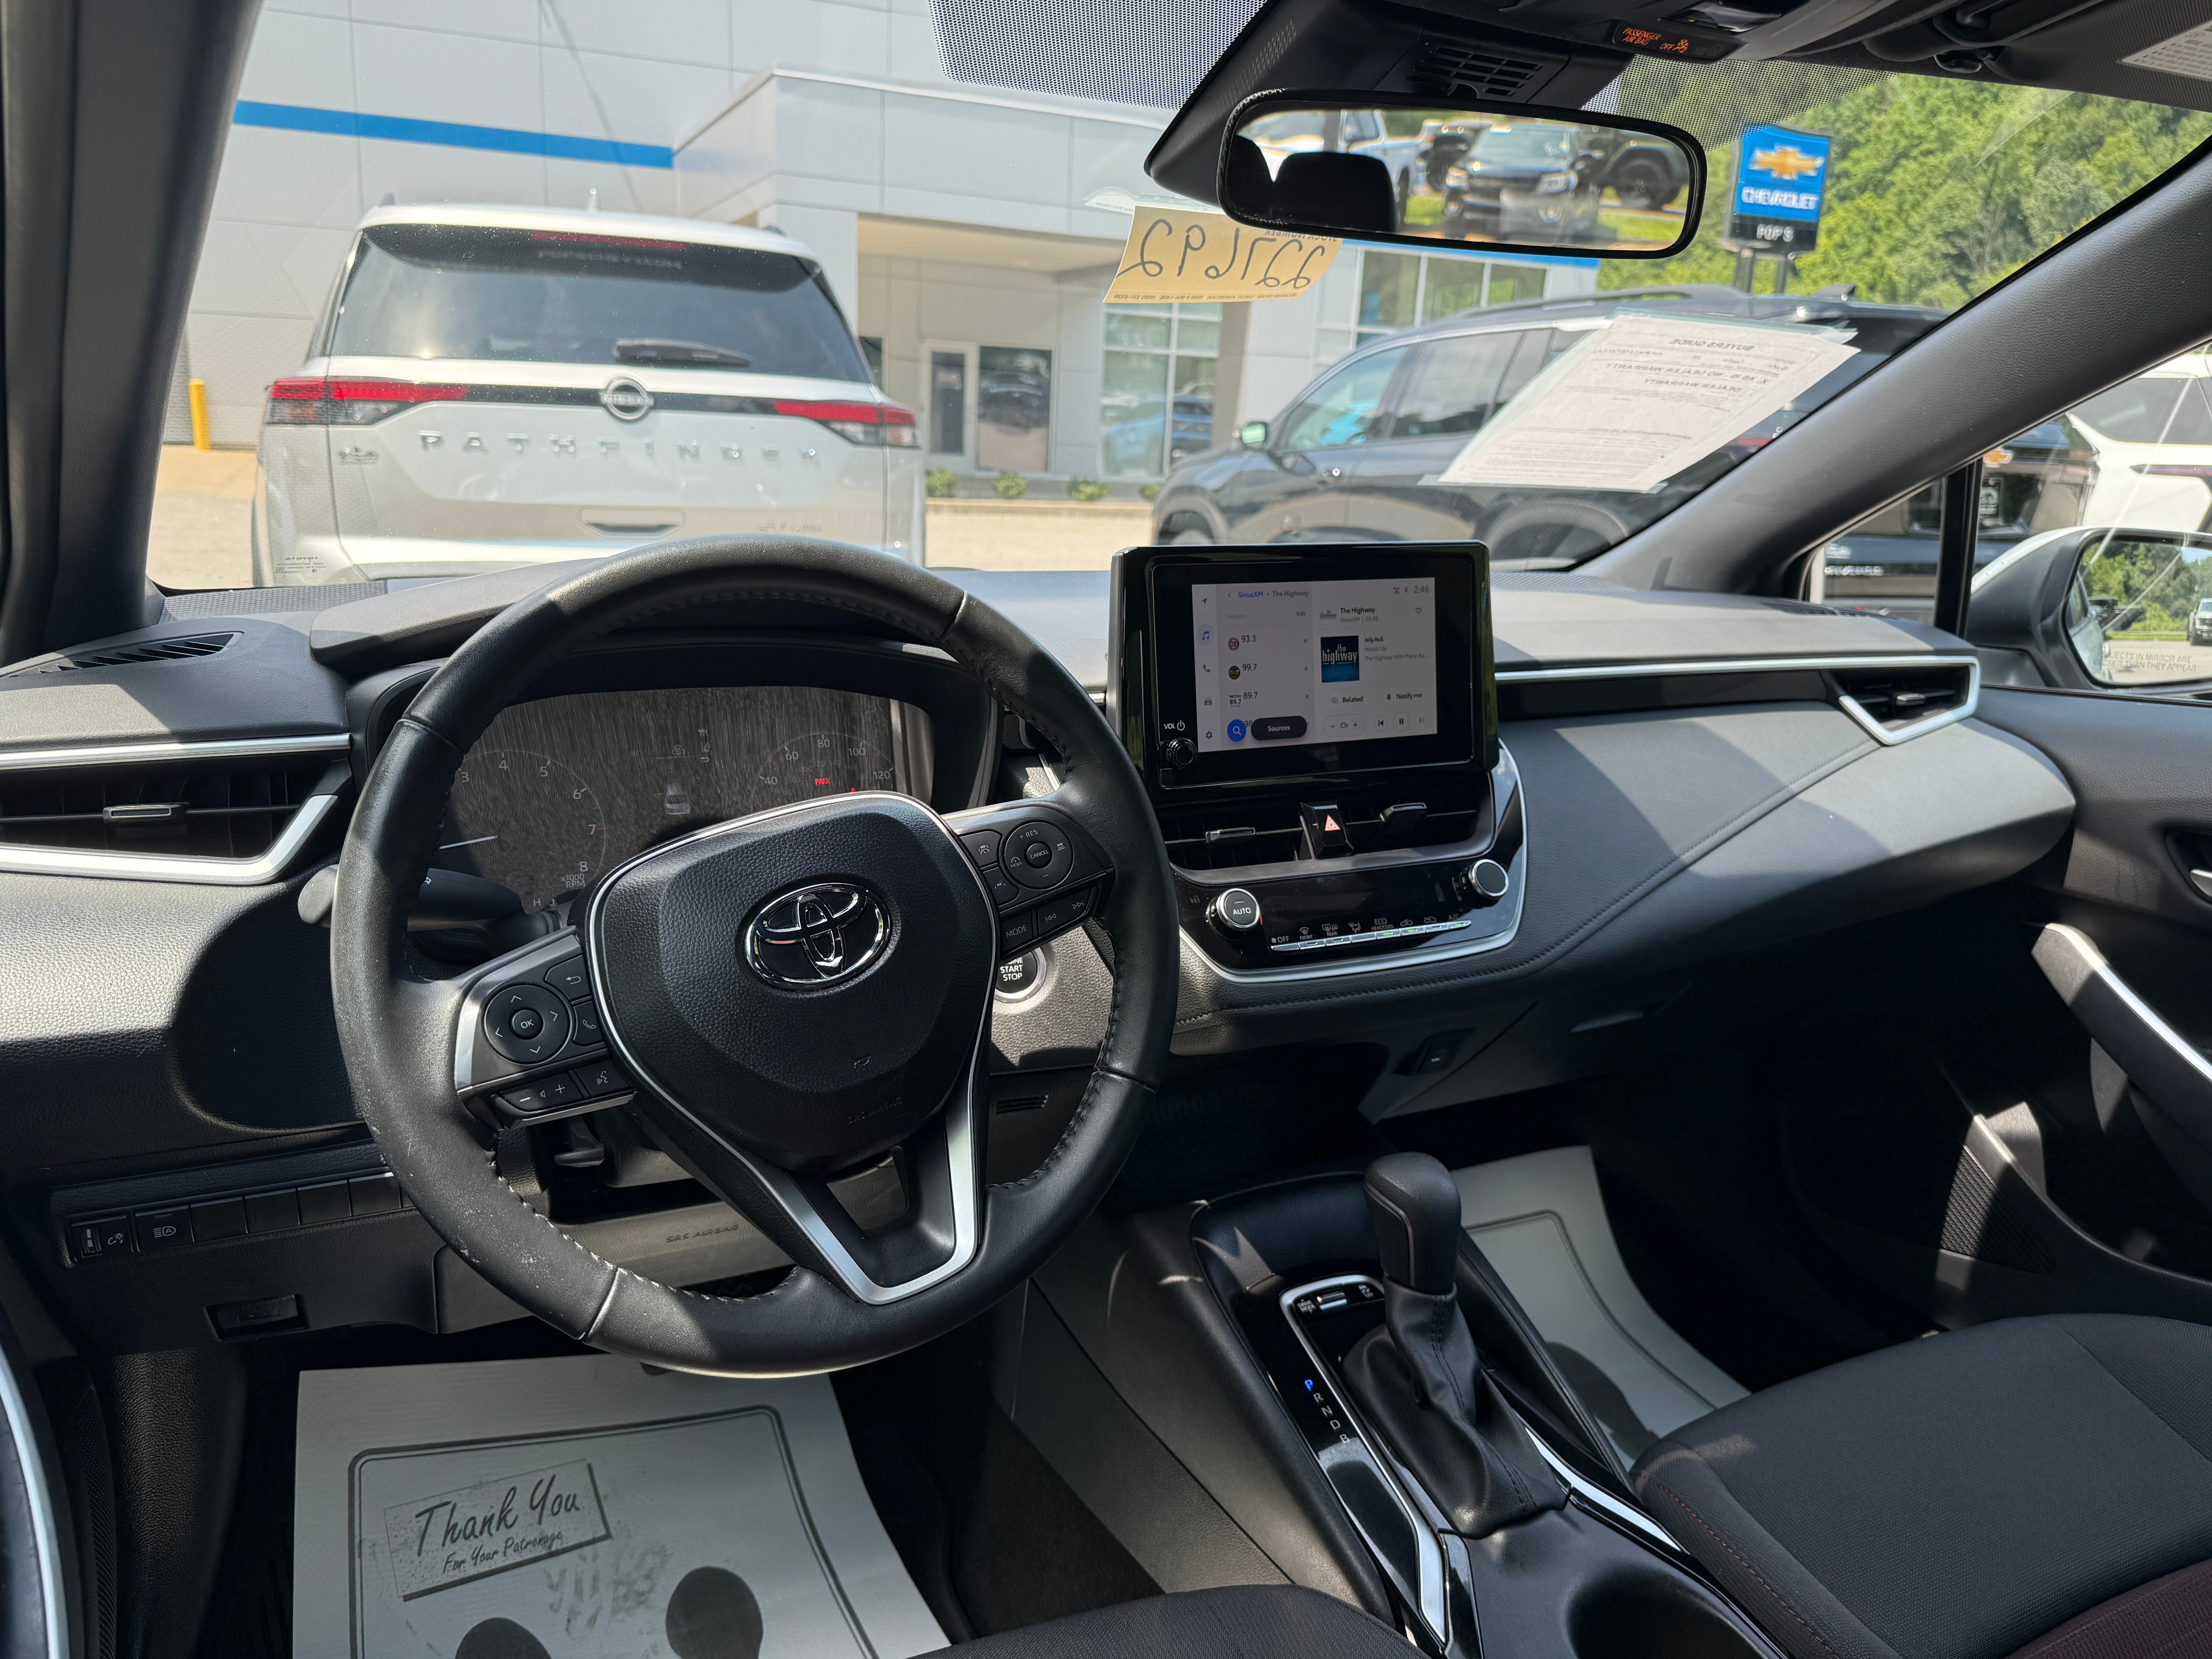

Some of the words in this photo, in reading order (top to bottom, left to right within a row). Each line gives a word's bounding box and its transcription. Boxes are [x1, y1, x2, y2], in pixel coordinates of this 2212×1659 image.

[1623, 27, 1661, 41] PASSENGER
[1741, 186, 1819, 210] CHEVROLET
[417, 430, 819, 463] PATHFINDER
[1284, 590, 1309, 598] Highway
[1414, 585, 1429, 594] 2:46
[1351, 606, 1376, 615] Highway
[1241, 635, 1257, 643] 93.3
[1337, 643, 1346, 653] the
[1322, 649, 1358, 665] highway
[2104, 651, 2134, 659] JECTS
[2136, 653, 2143, 661] IN
[2145, 653, 2176, 662] MIRROR
[2176, 655, 2193, 664] ARE
[2146, 662, 2167, 670] THEY
[2167, 663, 2197, 673] APPEAR
[817, 739, 831, 748] 80
[785, 752, 799, 761] 60
[848, 747, 866, 756] 100
[499, 760, 508, 771] 4
[541, 766, 548, 777] 5
[872, 770, 890, 780] 120
[462, 772, 470, 783] 3
[764, 776, 778, 785] 40
[573, 789, 582, 799] 6
[588, 824, 596, 835] 7
[1025, 829, 1038, 838] RES
[1030, 849, 1049, 859] CANCEL
[580, 861, 589, 872] 8
[562, 874, 585, 882] x1000
[566, 880, 586, 889] RPM
[533, 898, 541, 907] H
[1233, 907, 1251, 915] AUTO
[1006, 924, 1027, 938] MODE
[1000, 965, 1023, 974] START
[1003, 972, 1023, 981] STOP
[521, 1019, 534, 1029] OK
[666, 1233, 690, 1243] SRS
[692, 1224, 739, 1238] AIRBAG
[1305, 1379, 1313, 1391] P
[1313, 1393, 1324, 1404] R
[1321, 1405, 1333, 1417] N
[1329, 1419, 1341, 1431] D
[1339, 1434, 1350, 1443] B
[415, 1485, 519, 1557] Thank
[529, 1474, 580, 1525] You
[443, 1552, 465, 1573] For
[471, 1546, 498, 1566] Your
[504, 1531, 563, 1556] Patronage
